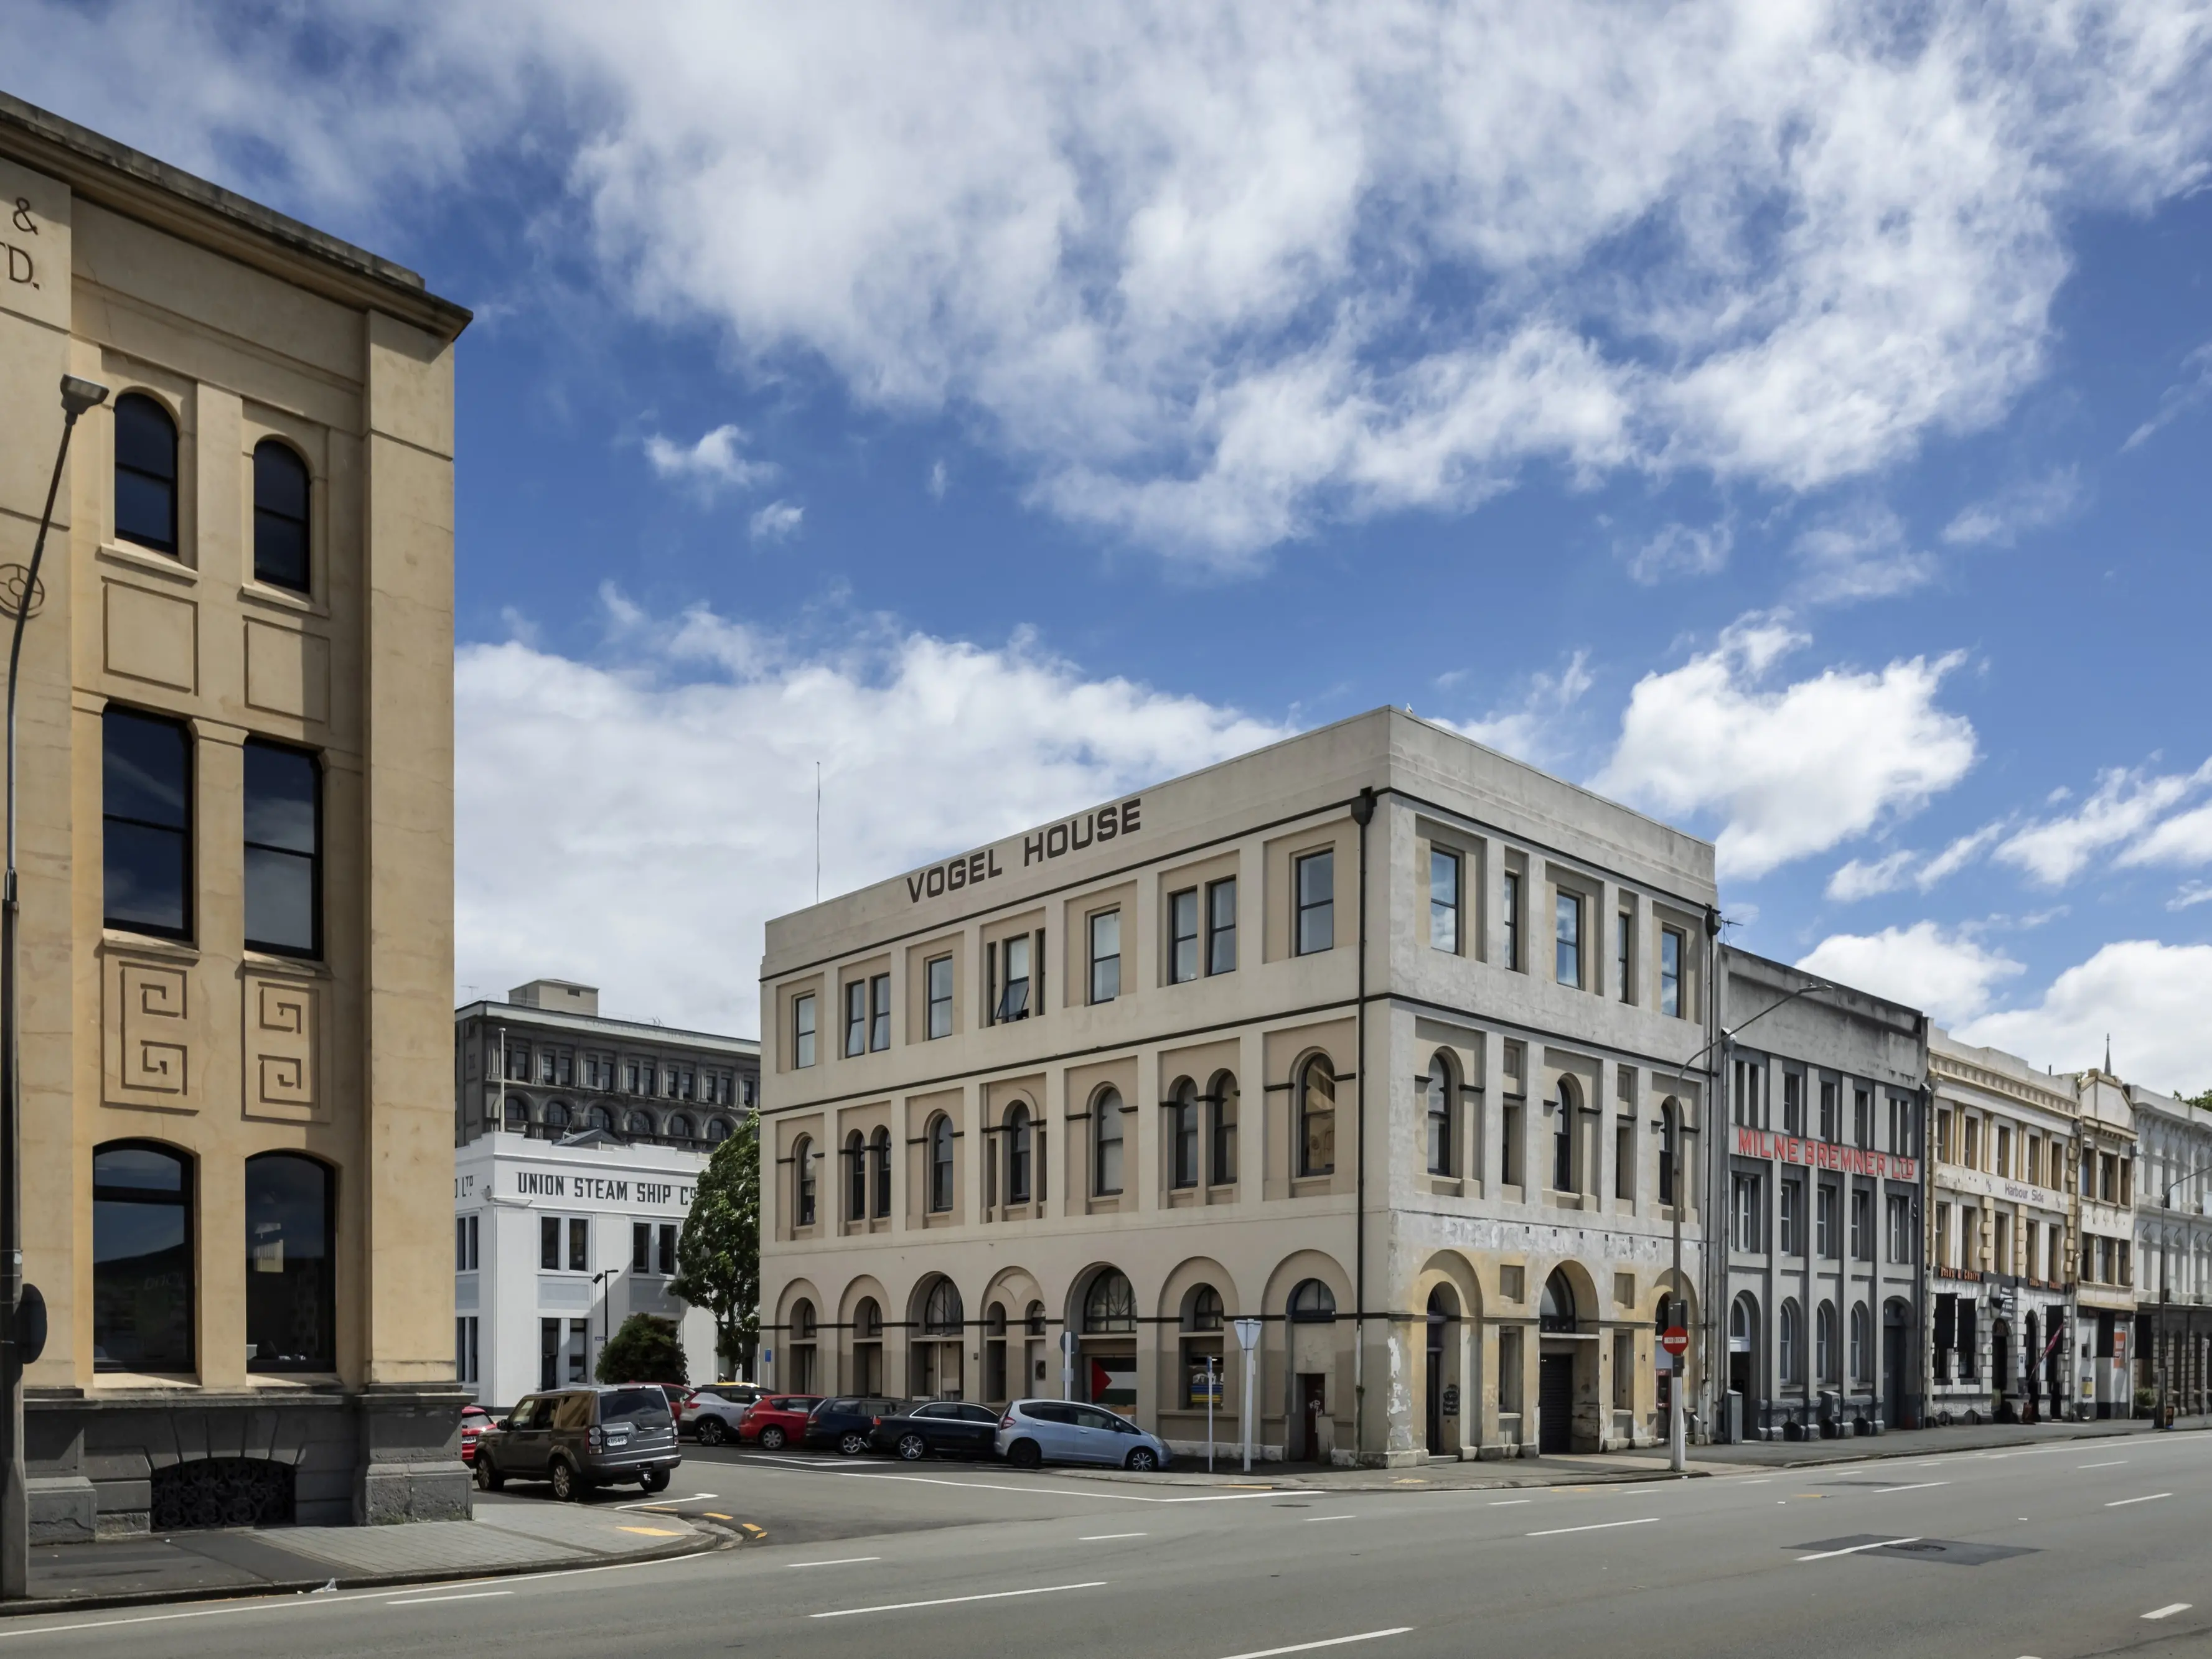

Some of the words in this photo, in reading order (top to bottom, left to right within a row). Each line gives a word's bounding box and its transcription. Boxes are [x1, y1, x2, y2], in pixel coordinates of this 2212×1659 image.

[12, 197, 39, 235] &
[0, 241, 40, 290] D.
[906, 849, 1003, 904] VOGEL
[1024, 798, 1141, 867] HOUSE
[1738, 1128, 1799, 1162] MILNE
[1805, 1140, 1886, 1177] BREMNER
[1892, 1156, 1915, 1179] LTD
[518, 1172, 564, 1196] UNION
[574, 1177, 628, 1201] STEAM
[637, 1182, 671, 1204] SHIP
[2005, 1182, 2028, 1200] Harbour
[2032, 1189, 2044, 1203] Side
